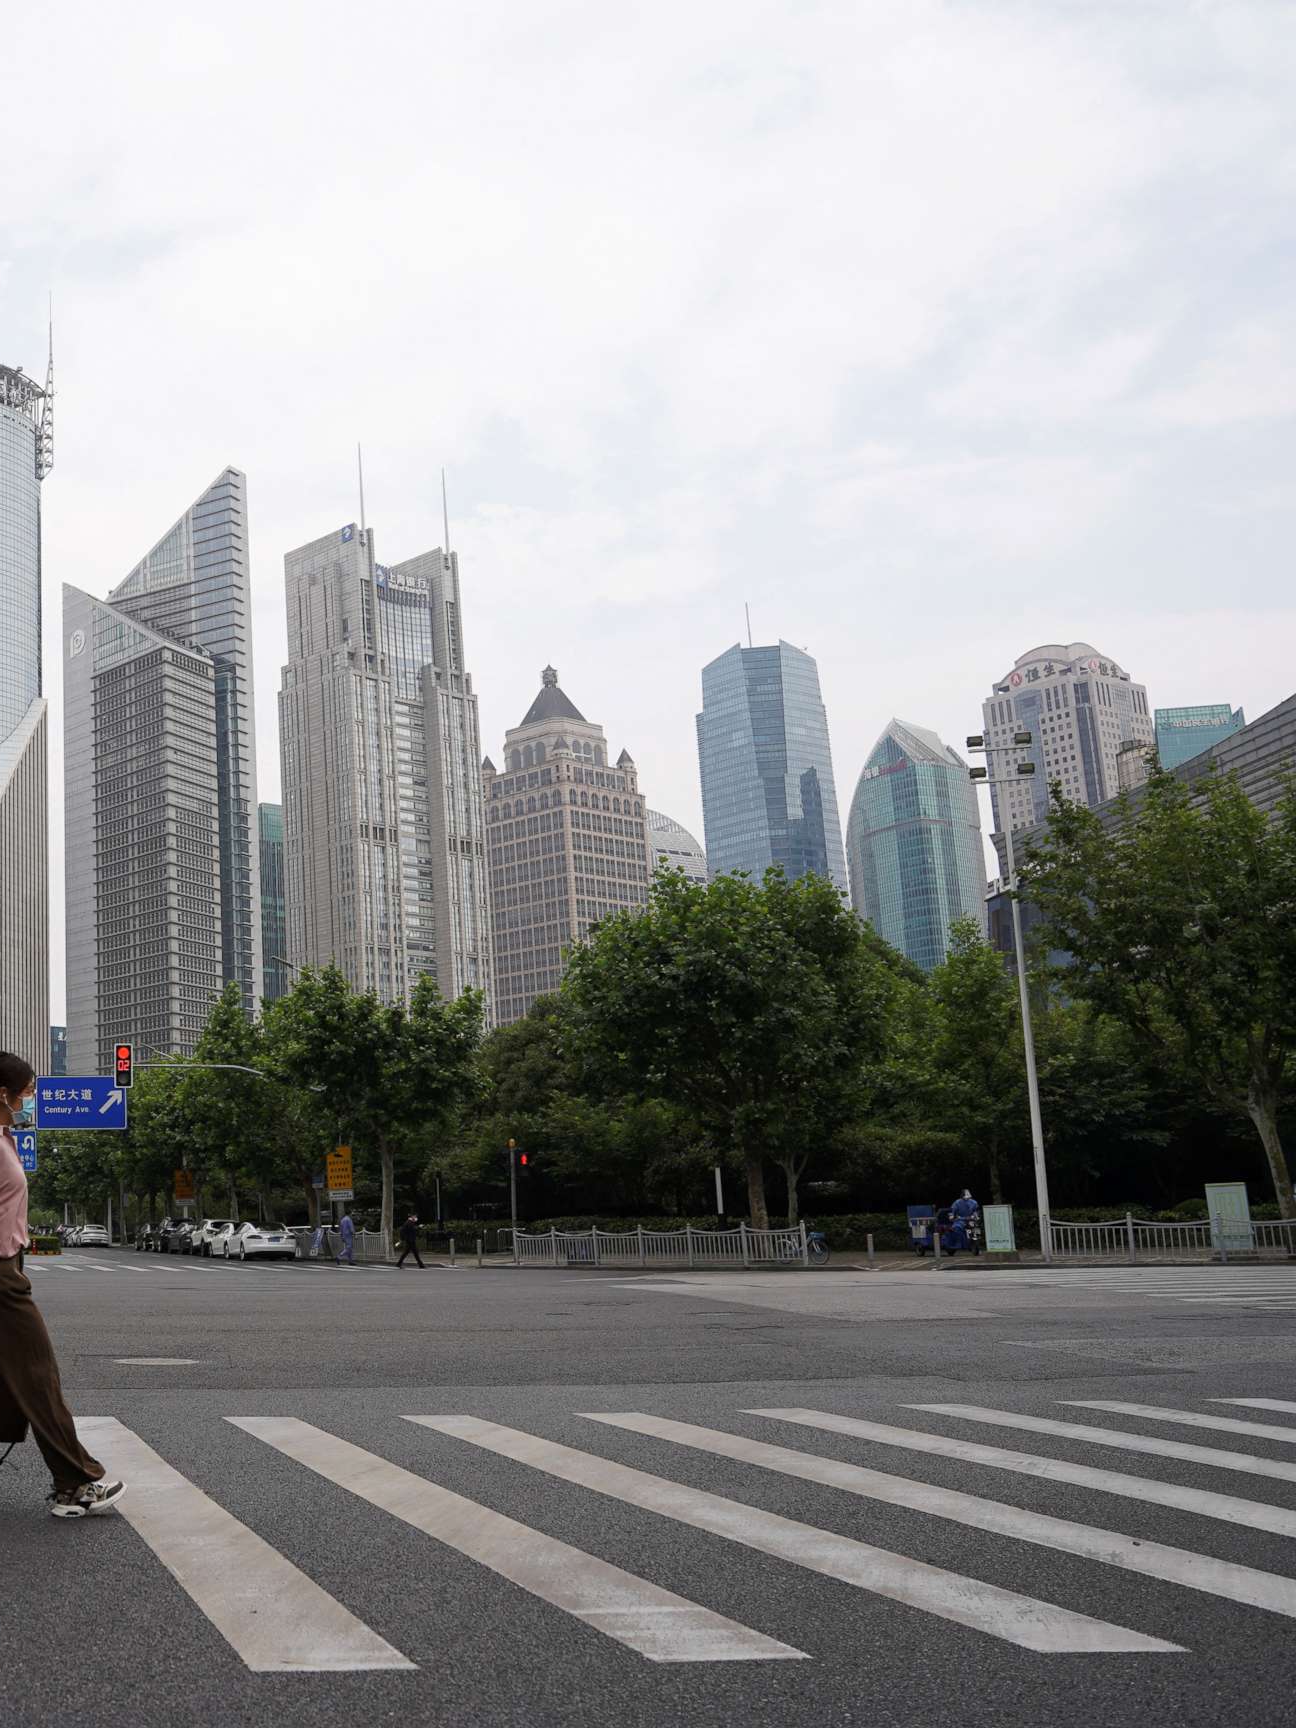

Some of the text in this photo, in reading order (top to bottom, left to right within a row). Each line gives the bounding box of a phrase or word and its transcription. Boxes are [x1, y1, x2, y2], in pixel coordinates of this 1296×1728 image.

[118, 1060, 129, 1071] 02
[42, 1089, 93, 1101] 世纪大道
[44, 1106, 72, 1115] Century
